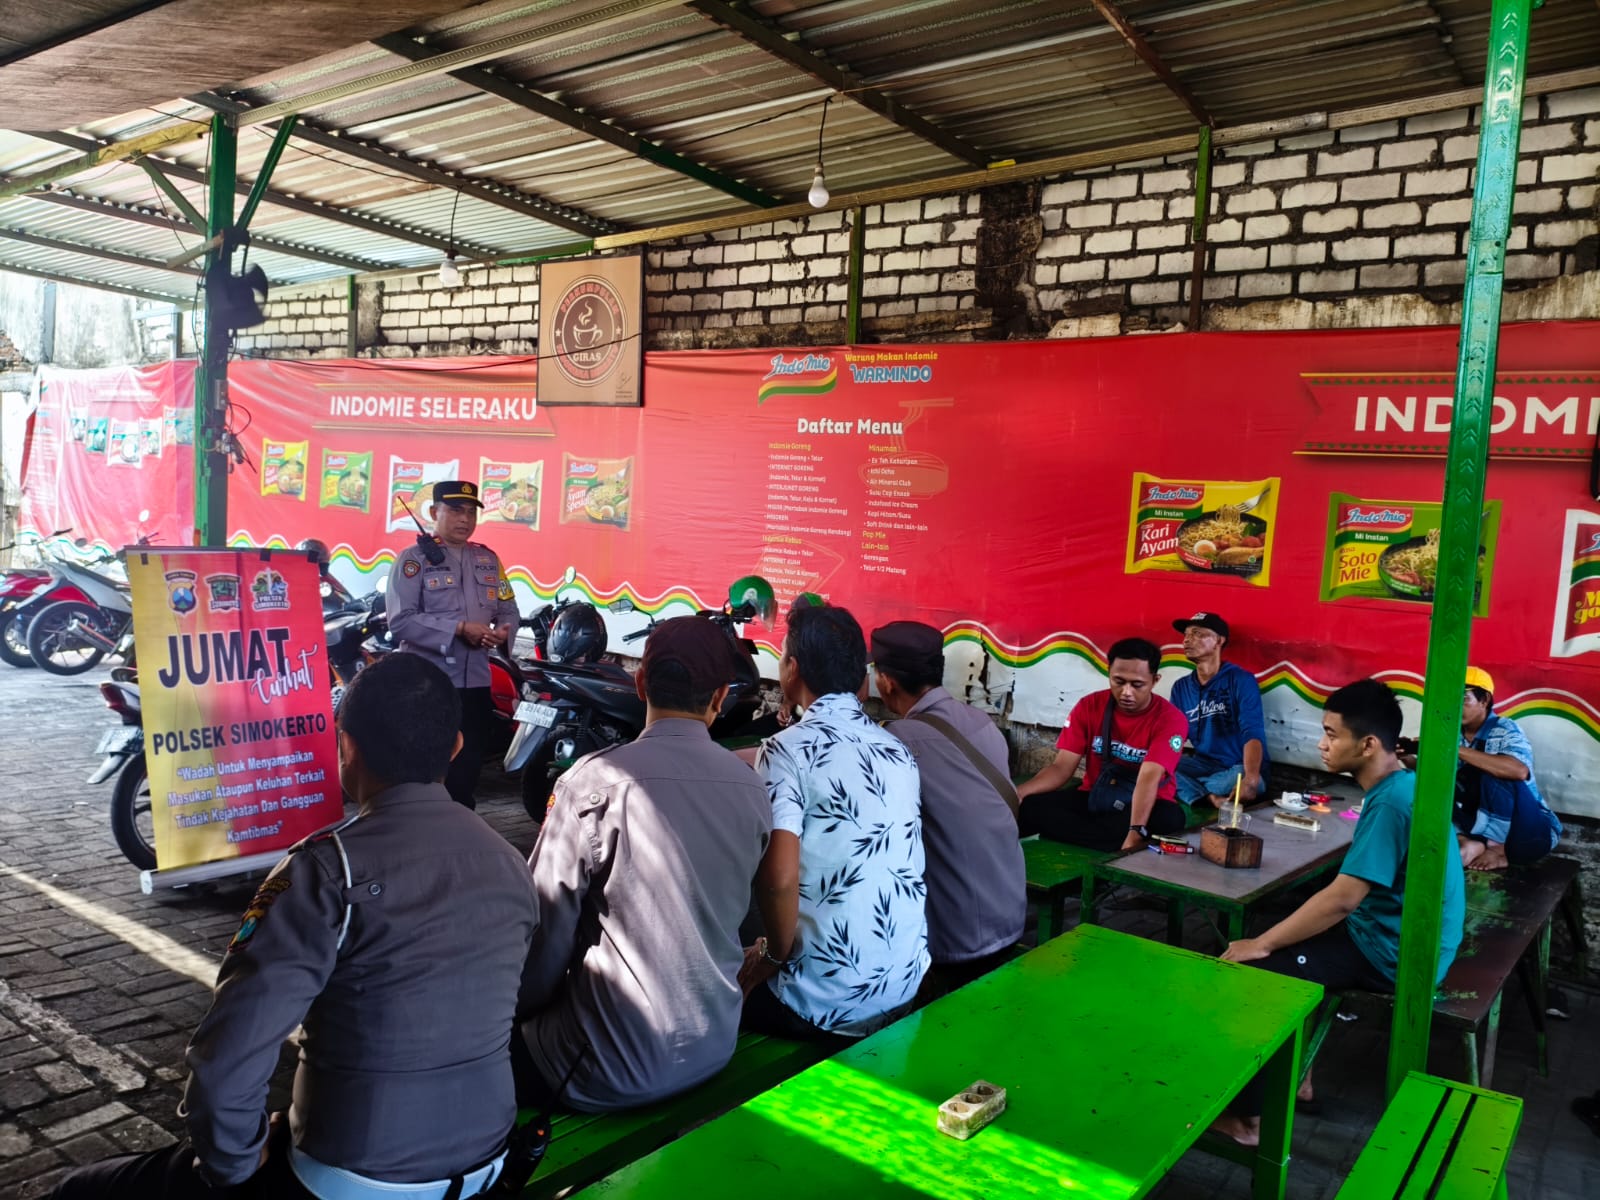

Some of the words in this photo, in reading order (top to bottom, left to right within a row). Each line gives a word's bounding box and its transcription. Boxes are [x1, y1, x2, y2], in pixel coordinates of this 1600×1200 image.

[845, 353, 875, 363] Warung
[876, 352, 903, 361] Makan
[905, 351, 938, 361] Indomie
[850, 364, 932, 383] WARMINDO
[330, 395, 415, 418] INDOMIE
[420, 397, 536, 420] SELERAKU
[797, 417, 853, 434] Daftar
[857, 418, 903, 435] Menu
[1154, 509, 1162, 517] Mi
[862, 530, 874, 539] Pop
[1141, 523, 1170, 542] Kari
[1365, 533, 1389, 541] Instan
[1139, 537, 1179, 557] Ayam
[1339, 552, 1377, 569] Soto
[1340, 567, 1371, 583] Mie
[158, 627, 290, 688] JUMAT
[250, 644, 318, 705] Curhat
[153, 725, 226, 755] POLSEK
[231, 712, 327, 745] SIMOKERTO
[217, 759, 246, 776] Untuk
[247, 751, 314, 773] Menyampaikan
[167, 789, 212, 807] Masukan
[215, 783, 255, 803] Ataupun
[255, 775, 293, 792] Keluhan
[294, 769, 325, 787] Terkait
[175, 812, 209, 830] Tindak
[210, 804, 259, 826] Kejahatan
[261, 798, 279, 813] Dan
[280, 791, 325, 812] Gangguan
